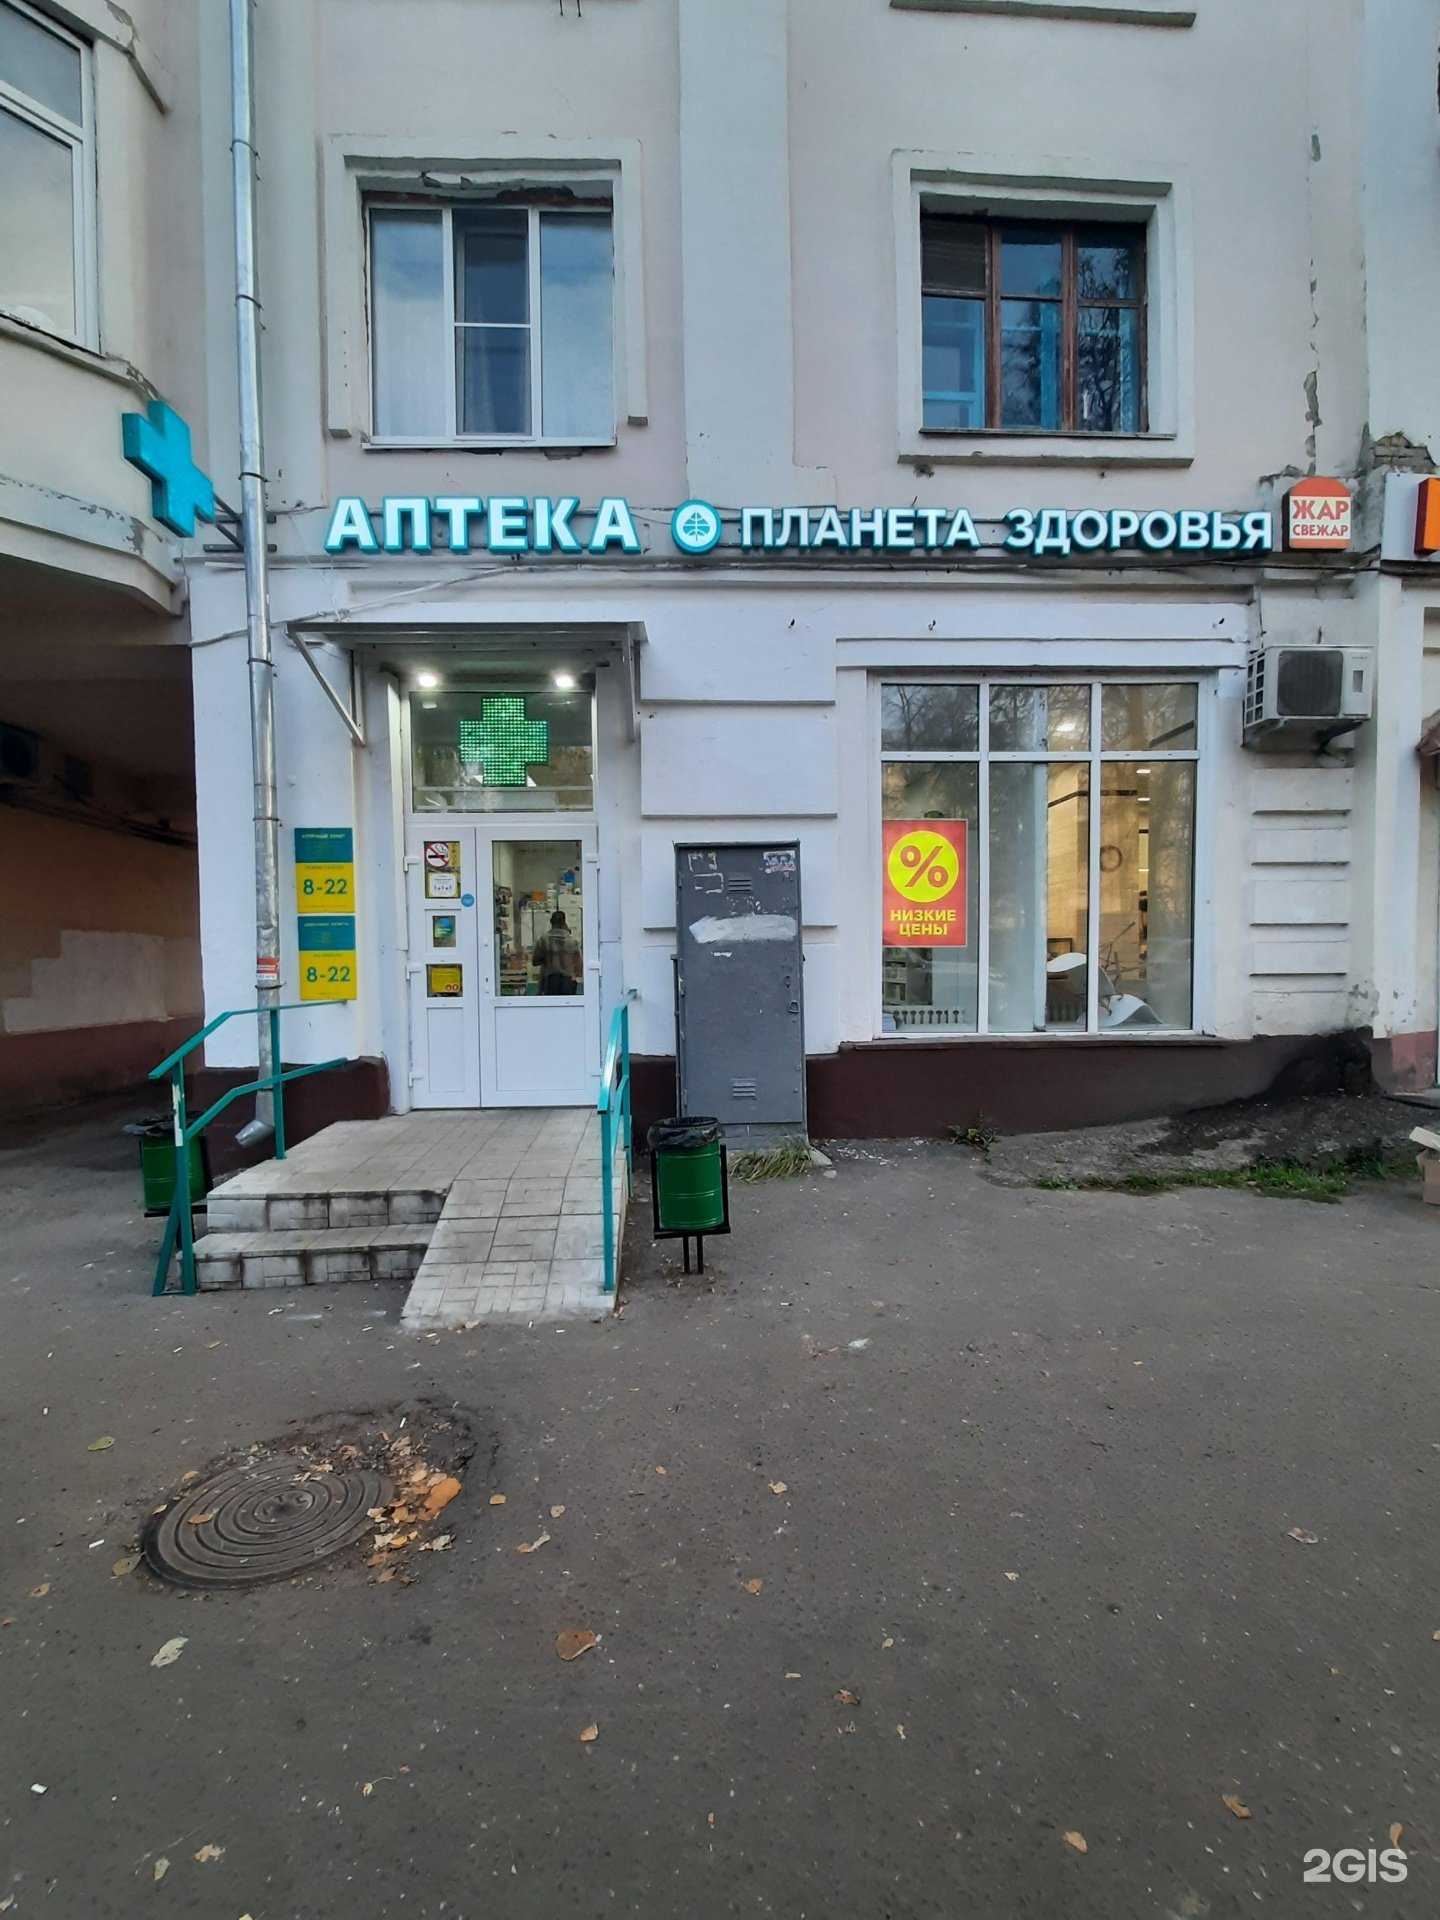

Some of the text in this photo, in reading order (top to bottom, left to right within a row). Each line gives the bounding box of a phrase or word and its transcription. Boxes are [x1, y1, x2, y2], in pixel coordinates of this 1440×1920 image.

[1292, 499, 1350, 521] ЖАР
[324, 496, 1274, 556] АПТЕКА ПЛАНЕТА ЗДОРОВЬЯ
[1292, 524, 1349, 536] СВЕЖАР
[889, 909, 957, 922] НИЗКИЕ
[899, 923, 948, 937] ЦЕНЫ
